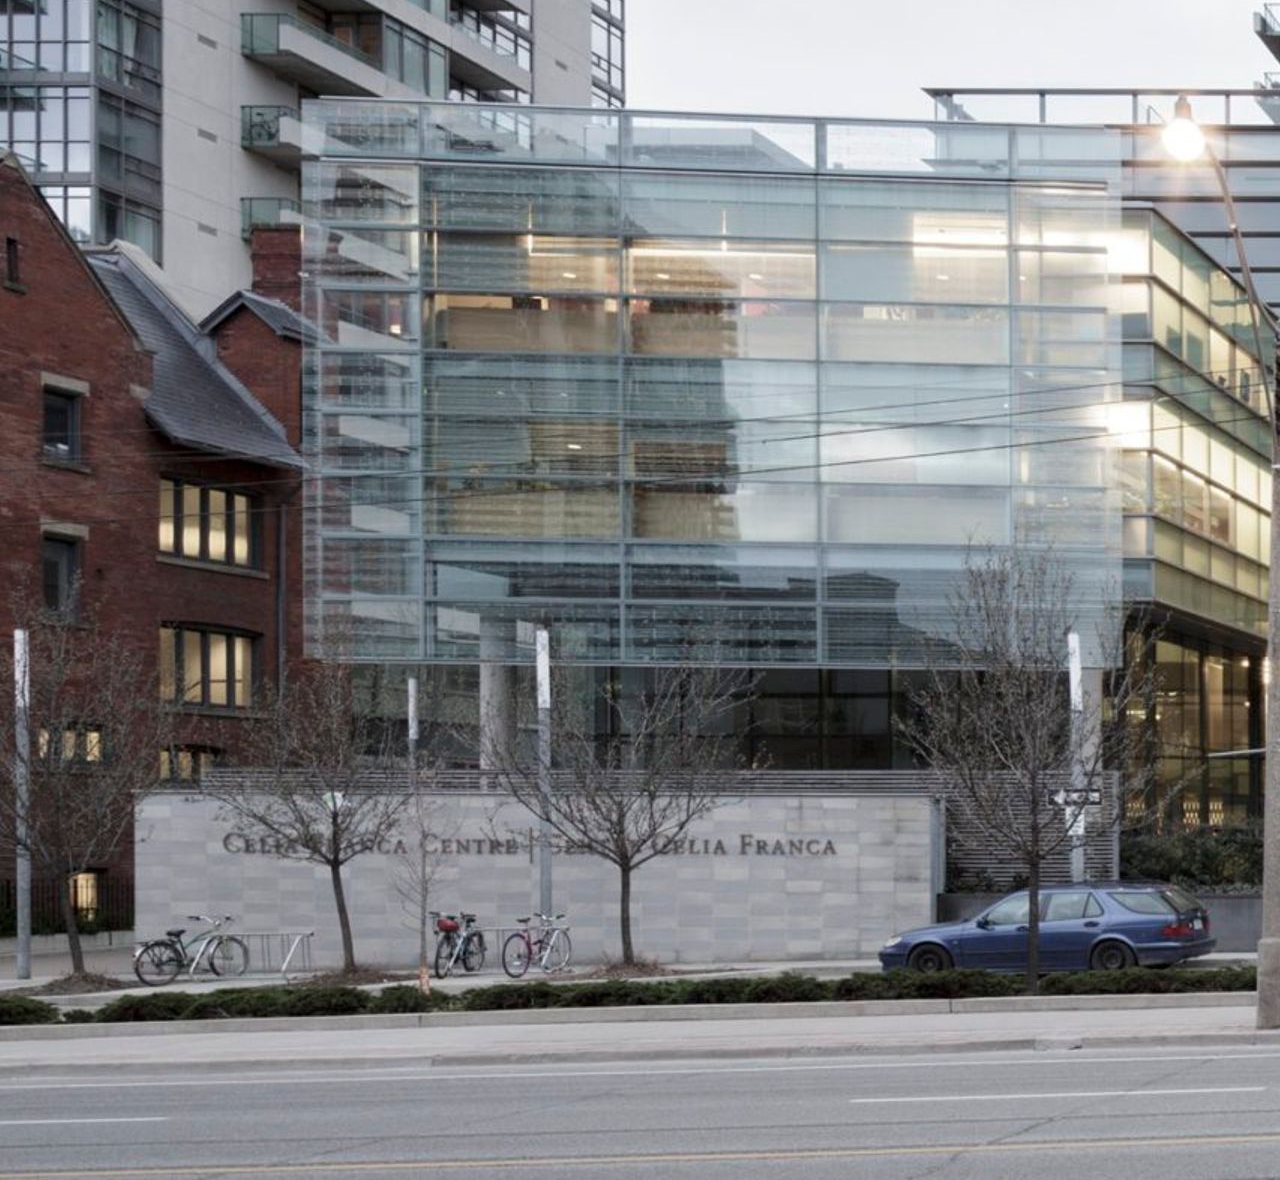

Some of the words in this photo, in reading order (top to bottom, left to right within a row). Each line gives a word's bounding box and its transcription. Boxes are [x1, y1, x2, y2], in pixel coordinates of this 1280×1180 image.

[421, 832, 518, 855] CENTRE
[651, 833, 727, 855] CELIA
[739, 834, 838, 856] FRANCA
